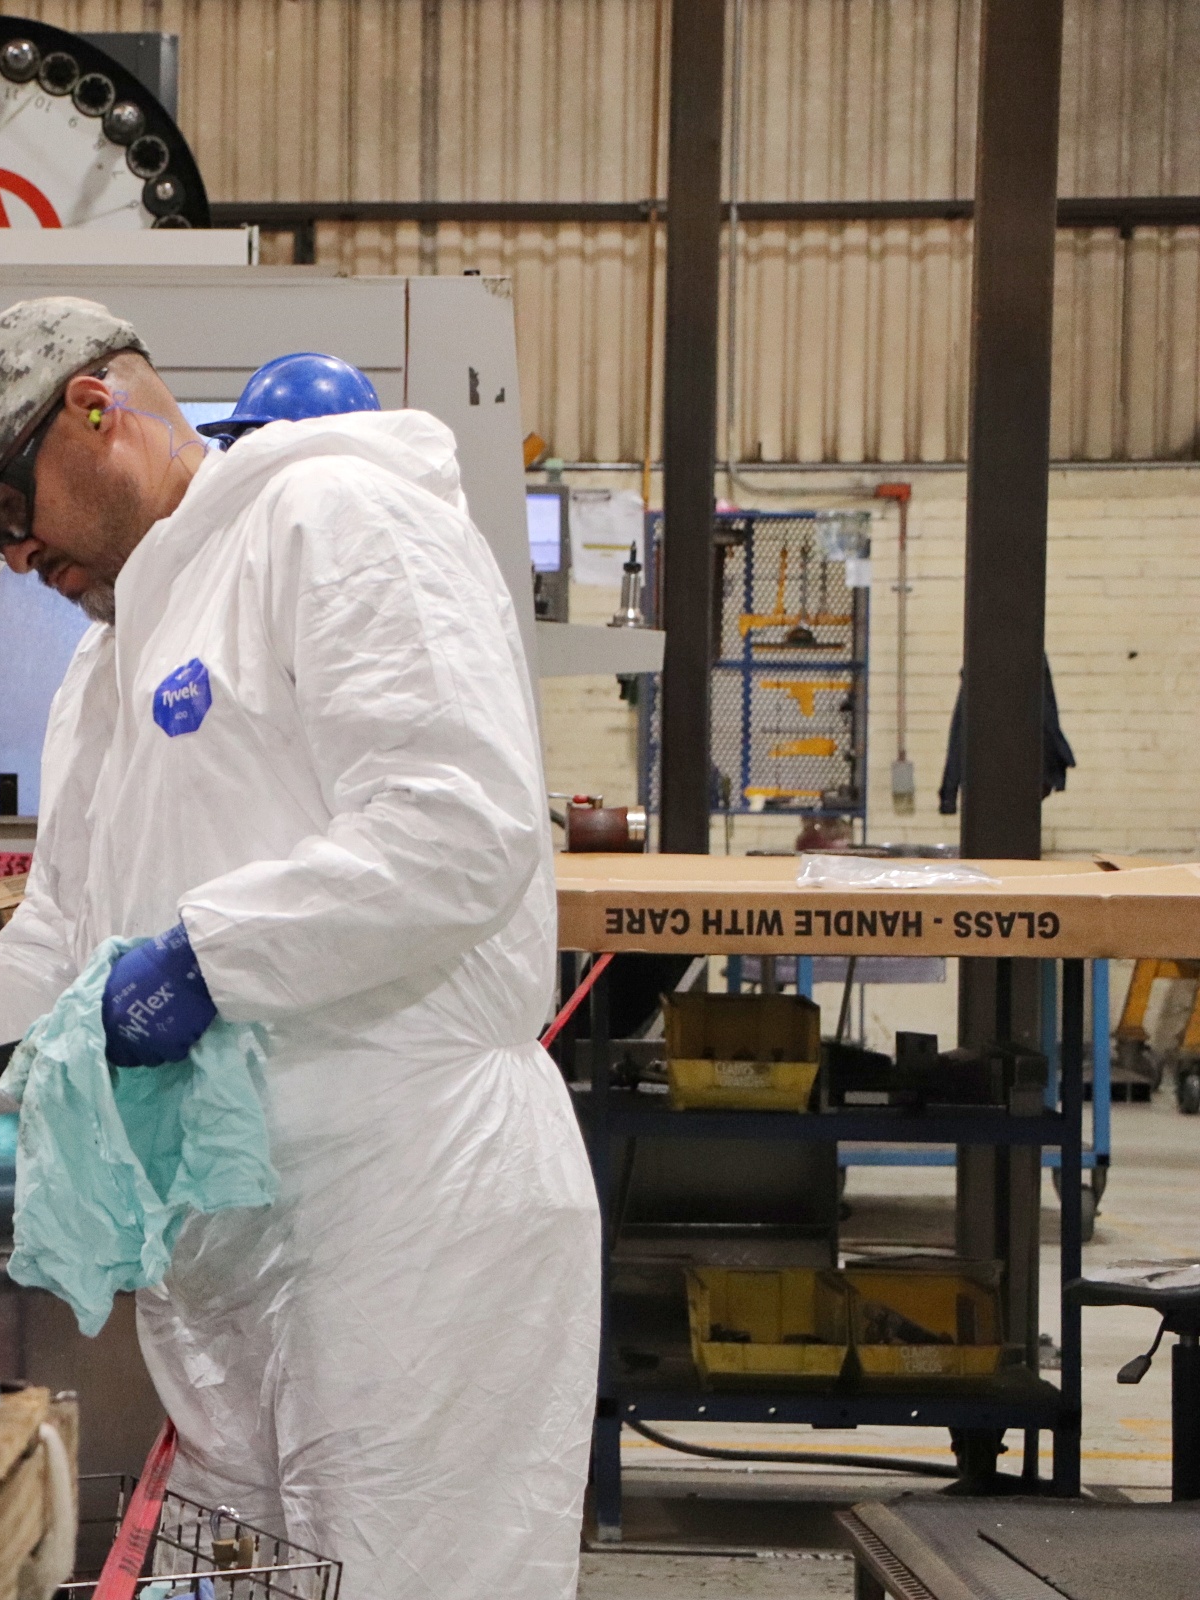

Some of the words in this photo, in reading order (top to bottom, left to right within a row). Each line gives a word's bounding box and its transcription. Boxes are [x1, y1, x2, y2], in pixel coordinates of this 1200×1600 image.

[35, 97, 51, 114] 10
[162, 681, 199, 709] Tyvek
[605, 907, 691, 935] CARE
[702, 908, 784, 936] WITH
[794, 909, 922, 938] HANDLE
[953, 910, 1061, 939] GLASS
[118, 985, 175, 1042] HyFlex
